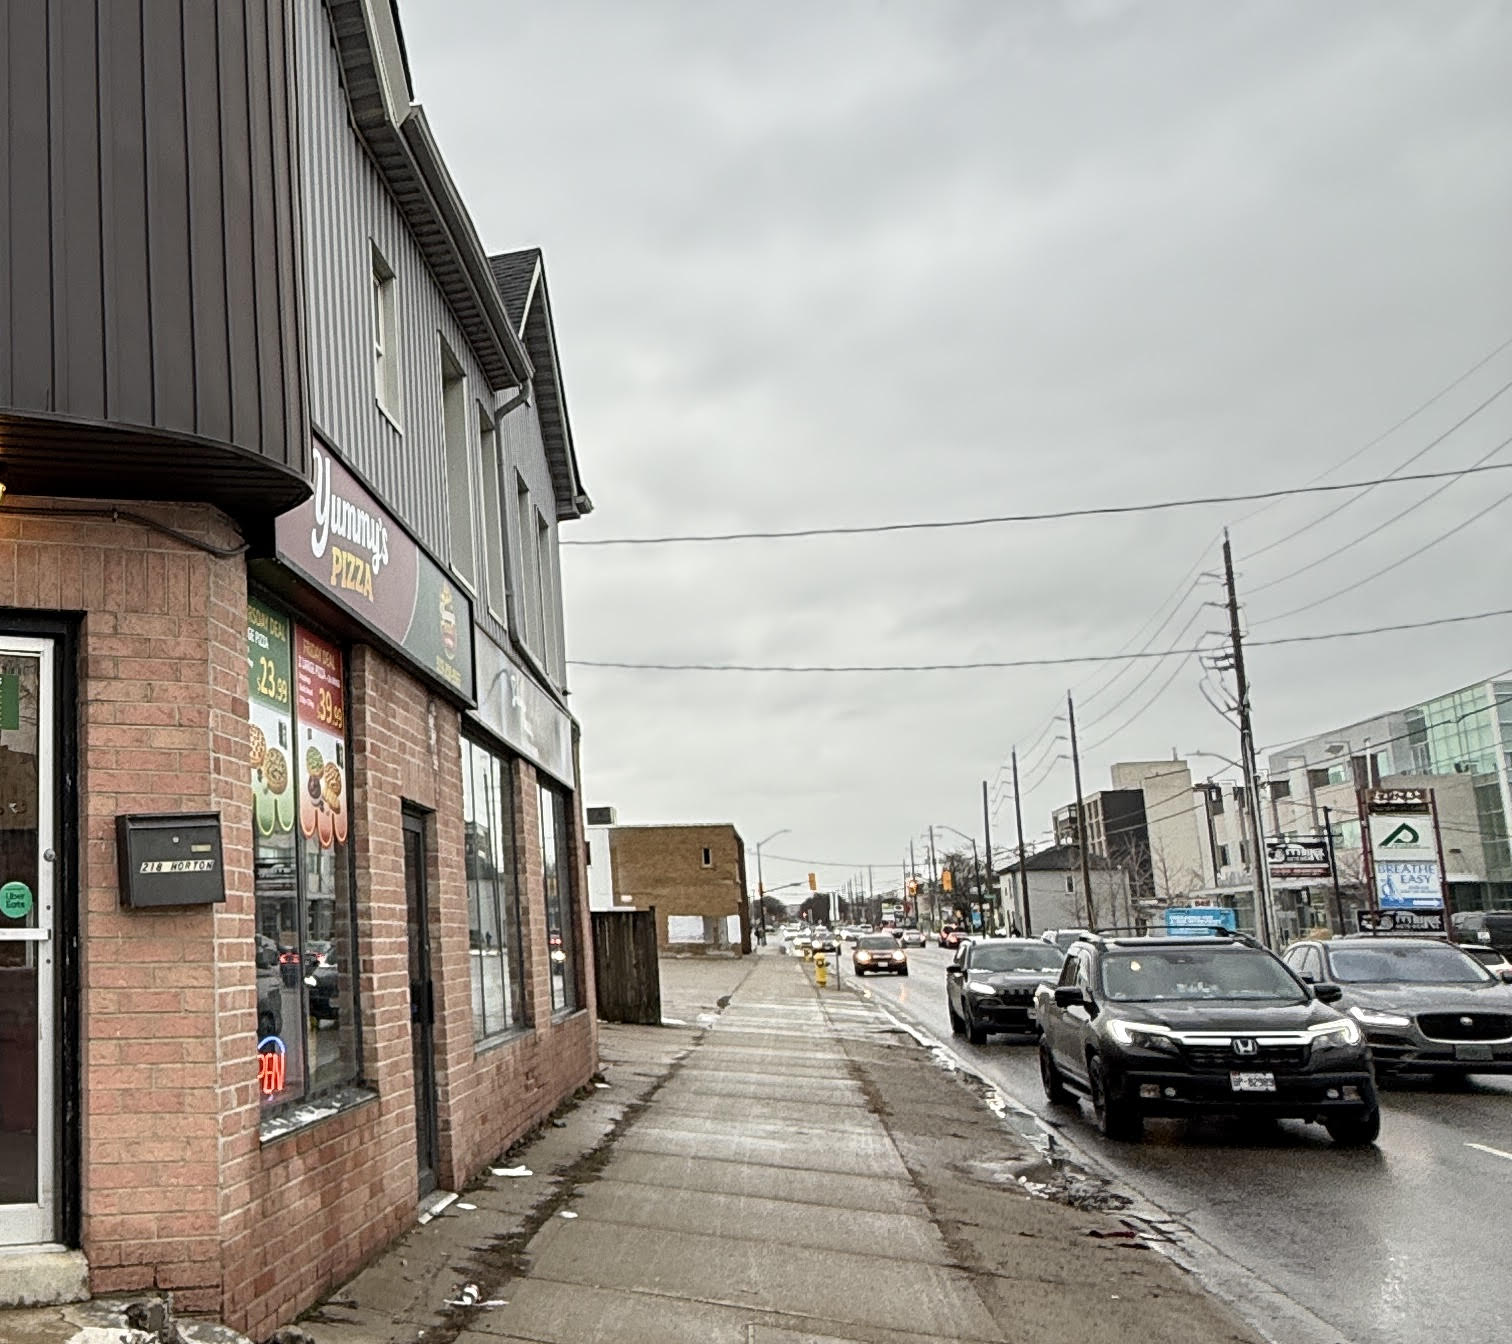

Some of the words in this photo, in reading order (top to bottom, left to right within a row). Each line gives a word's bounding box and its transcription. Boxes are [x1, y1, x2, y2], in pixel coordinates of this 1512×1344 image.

[311, 447, 389, 575] Yummy's
[330, 546, 374, 603] PIZZA
[142, 862, 163, 873] 218
[1400, 875, 1430, 884] EASY
[6, 892, 25, 900] Uber
[5, 900, 26, 909] Eats
